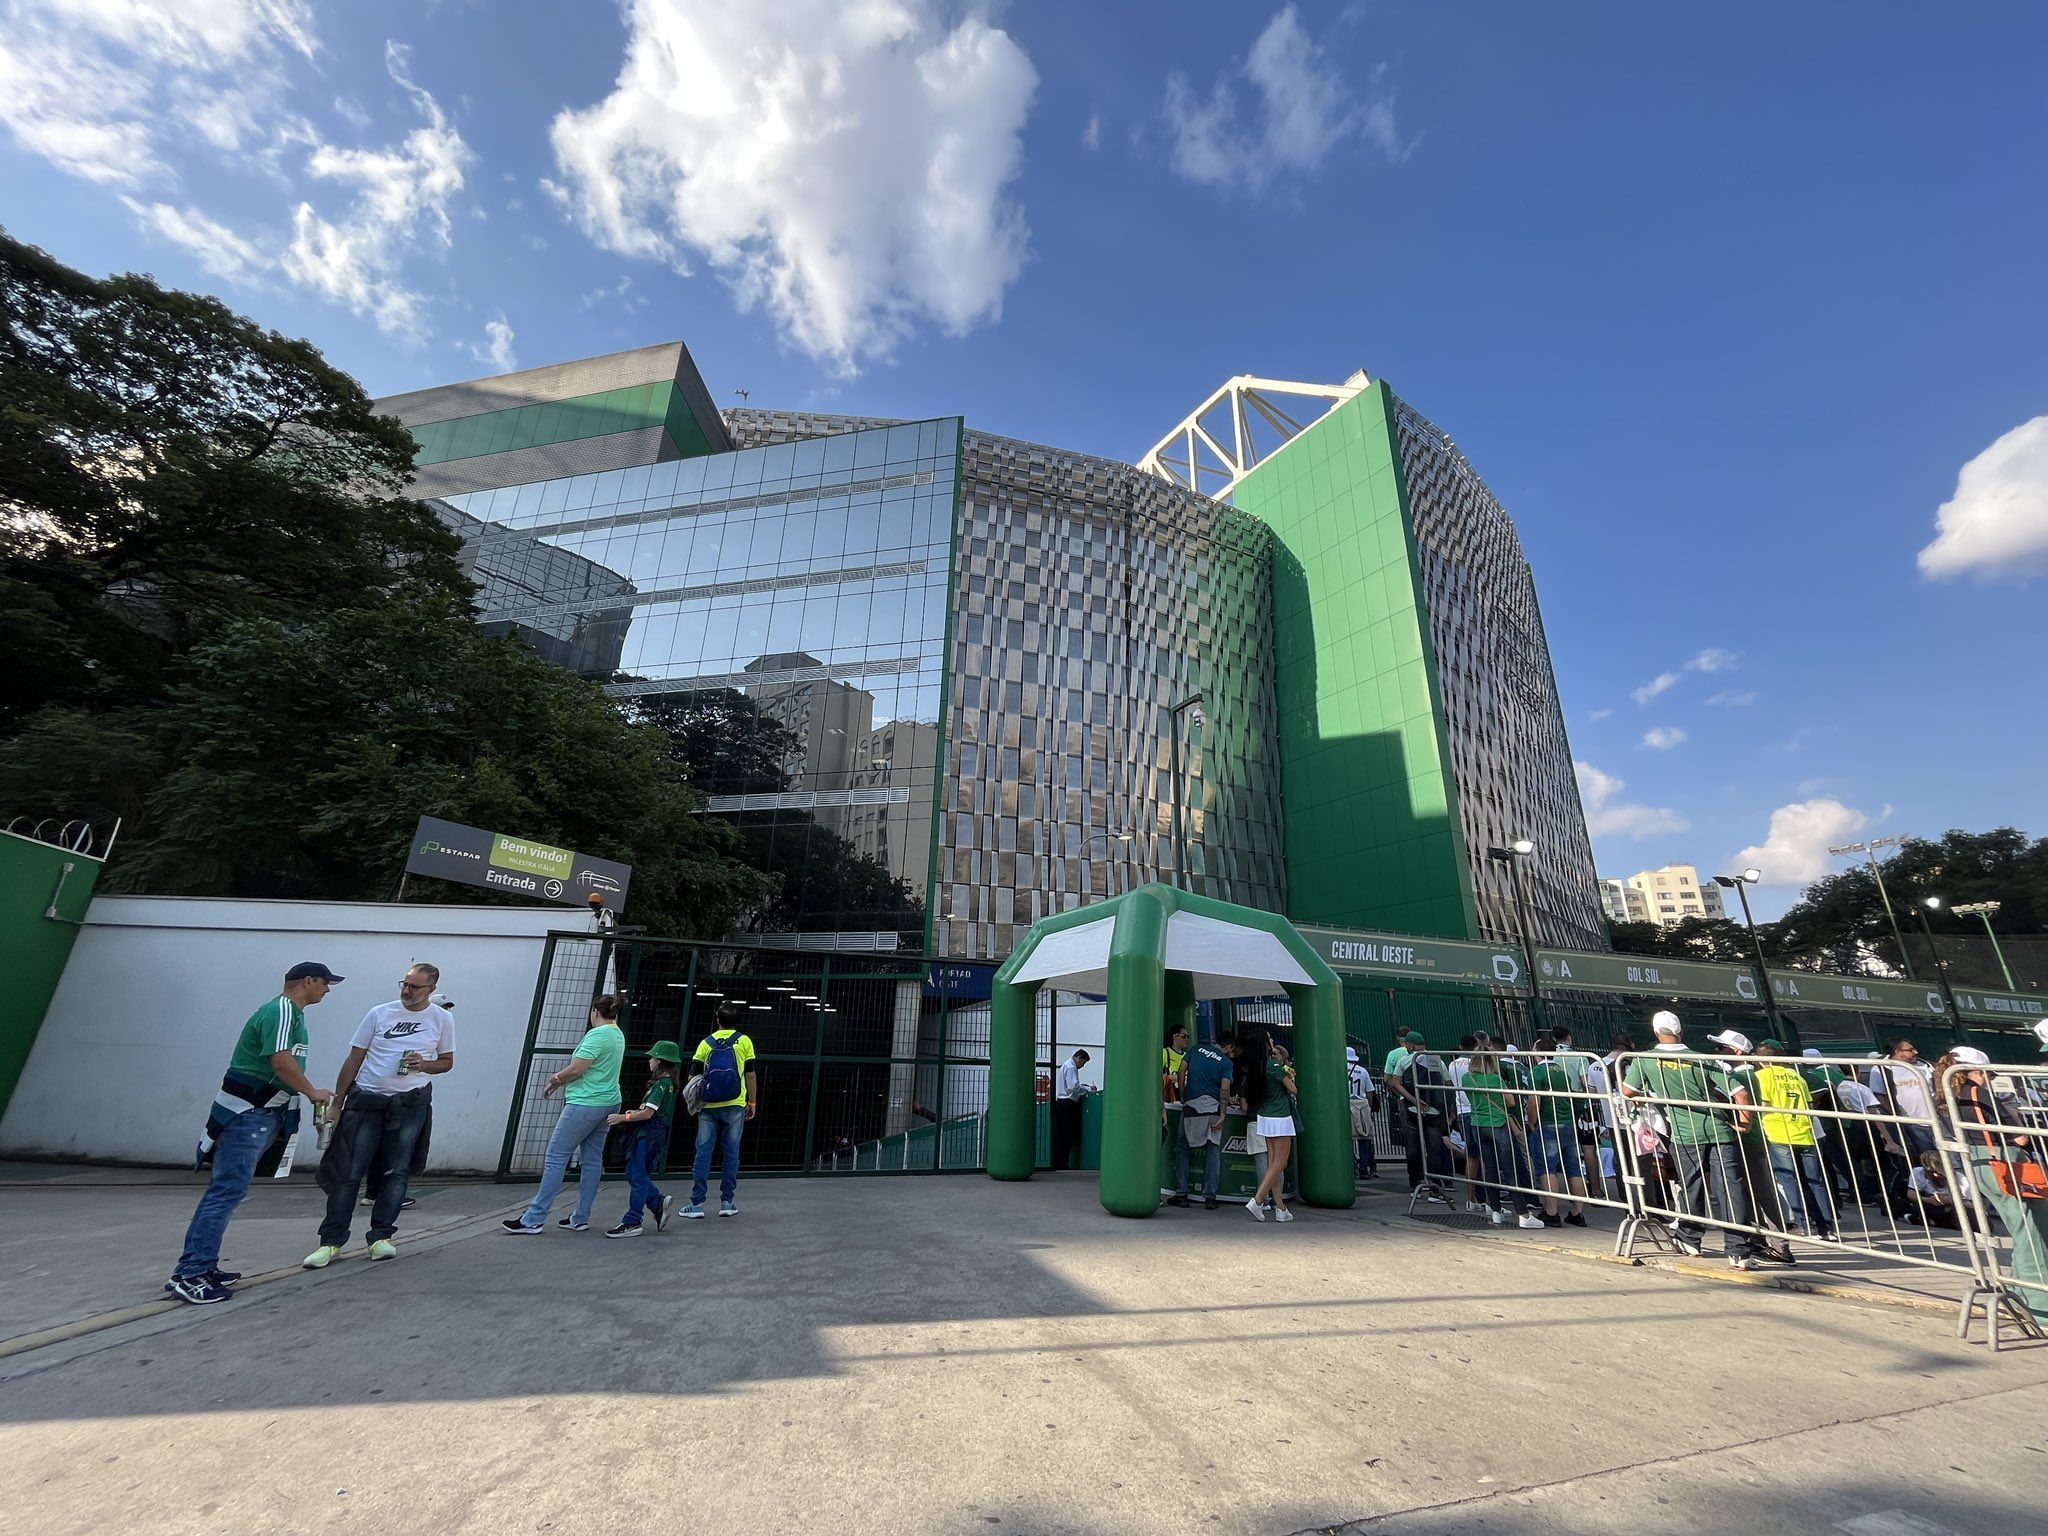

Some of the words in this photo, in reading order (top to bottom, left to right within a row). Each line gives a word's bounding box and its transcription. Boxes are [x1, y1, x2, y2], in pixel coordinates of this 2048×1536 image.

[440, 847, 481, 860] ESTAPAR
[500, 838, 527, 855] Bem
[529, 845, 567, 864] vindo!
[508, 856, 537, 869] PALESTRA
[486, 870, 537, 891] Entrada
[1332, 940, 1379, 962] CENTRAL
[1381, 944, 1414, 965] OESTE
[1561, 959, 1572, 978] A
[1627, 966, 1644, 983] GOL
[1645, 967, 1661, 984] SUL
[392, 1021, 422, 1033] NIKE
[1198, 1047, 1223, 1062] crefisa
[1786, 1092, 1801, 1122] 7
